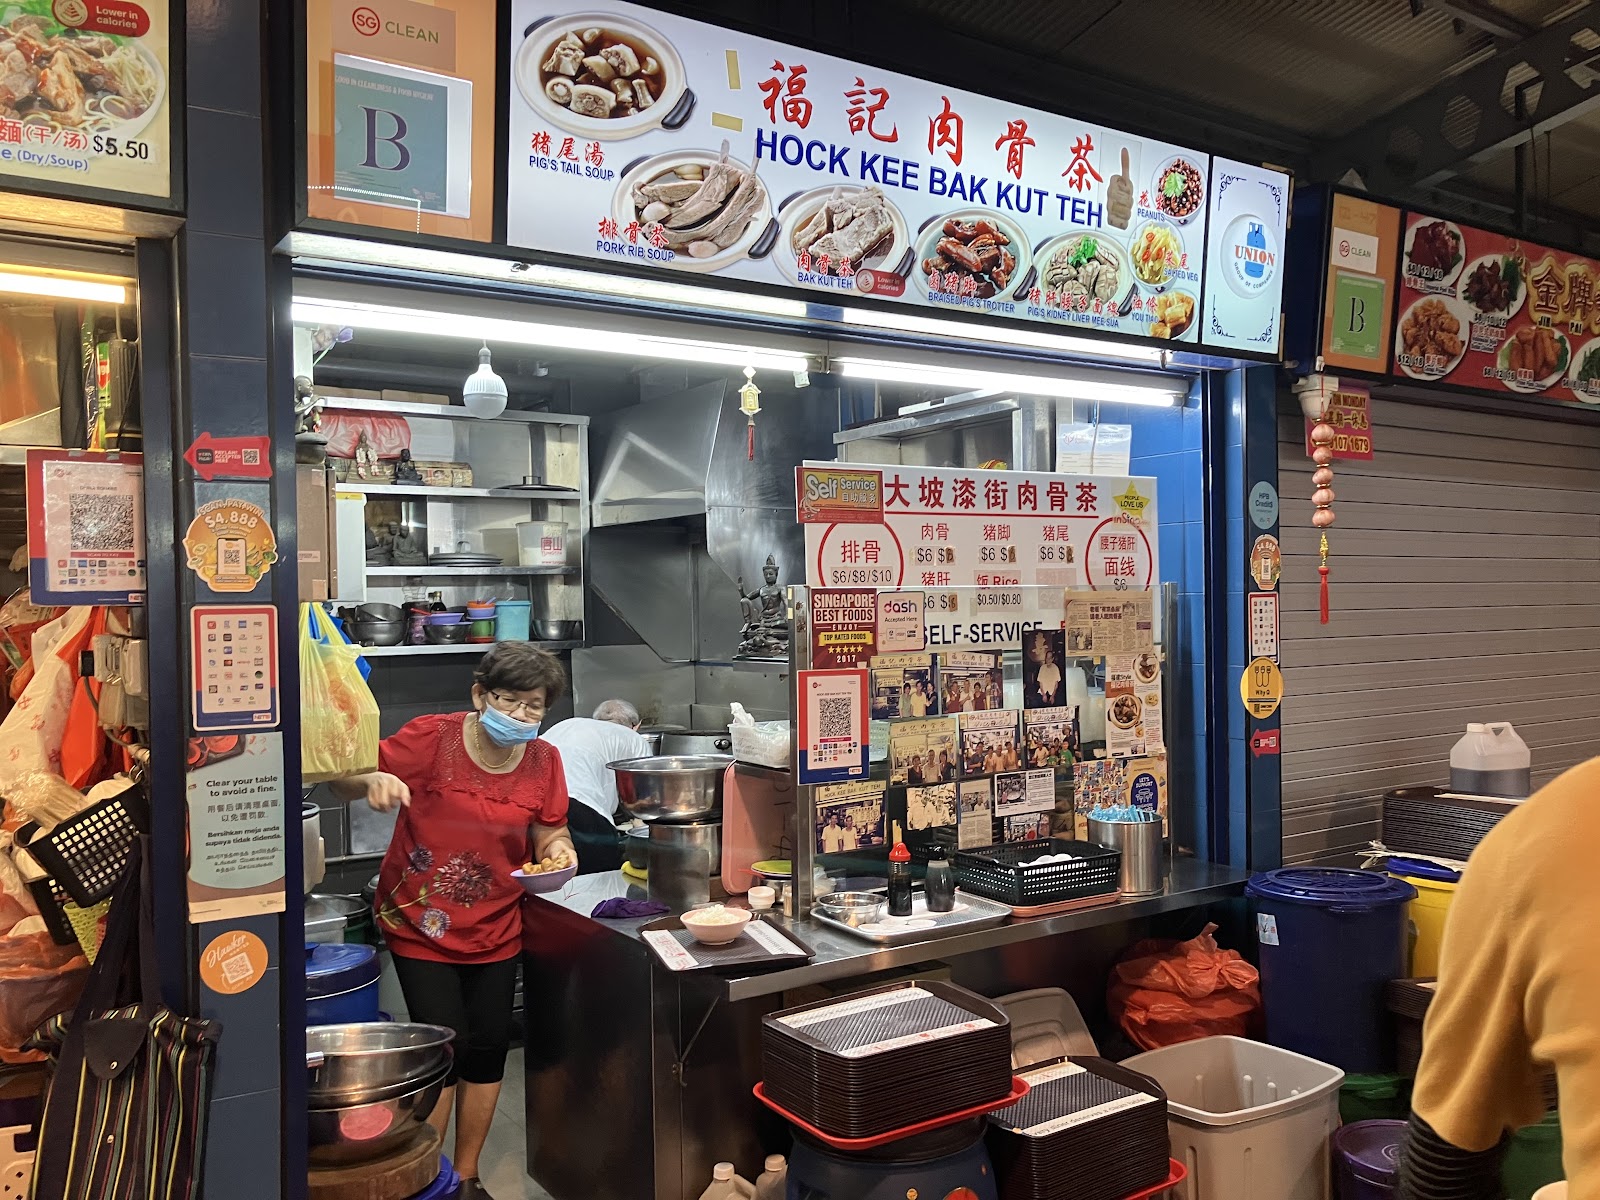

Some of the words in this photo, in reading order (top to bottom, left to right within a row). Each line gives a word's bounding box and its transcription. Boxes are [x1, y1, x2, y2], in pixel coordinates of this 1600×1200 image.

[96, 5, 127, 19] Lower
[129, 10, 138, 20] in
[96, 16, 137, 29] calories
[356, 14, 377, 29] SG
[385, 21, 439, 44] CLEAN
[757, 59, 1104, 193] 福記肉骨茶
[358, 104, 411, 171] B
[93, 134, 149, 160] $5.50
[17, 149, 88, 171] (Dry/Soup)
[529, 155, 558, 172] PIG'S
[560, 161, 583, 177] TAIL
[585, 166, 615, 181] SOUP
[755, 127, 850, 177] HOCK
[860, 150, 920, 192] KEE
[928, 165, 989, 205] BAK
[996, 181, 1050, 217] KUT
[1055, 193, 1104, 228] TEH
[1137, 207, 1165, 222] PEANUTS
[596, 240, 627, 256] PORK
[628, 245, 646, 258] RIB
[647, 248, 676, 262] SOUP
[1234, 244, 1275, 266] UNION
[1351, 246, 1371, 258] CLEAN
[837, 277, 854, 290] TEH
[1186, 271, 1199, 282] VEG
[983, 299, 1016, 314] TROTTER
[1131, 311, 1145, 321] YOU
[1348, 297, 1367, 333] B
[806, 473, 839, 501] Self
[840, 477, 877, 491] Service
[884, 473, 1098, 513] 大坡漆街肉骨茶
[1258, 492, 1270, 500] HPB
[1120, 500, 1135, 508] LOVE
[1135, 501, 1144, 509] US
[204, 511, 258, 529] $4,888
[921, 522, 950, 541] 肉骨
[983, 524, 1012, 541] 猪脚
[1043, 524, 1070, 542] 猪尾
[1100, 535, 1136, 552] 腰子猪肝
[841, 539, 881, 564] 排骨
[916, 548, 933, 562] $6
[980, 546, 996, 561] $6
[1040, 546, 1054, 561] $6
[1104, 556, 1136, 578] 面线
[832, 569, 893, 584] $6/$8/$10
[921, 571, 951, 587] 猪肝
[993, 575, 1019, 587] Rice
[1113, 578, 1129, 592] $6
[813, 593, 875, 608] SINGAPORE
[883, 599, 918, 613] dash
[976, 593, 1022, 606] $0.50/$0.80
[815, 609, 840, 622] BEST
[842, 609, 873, 621] FOODS
[832, 623, 859, 631] ENJOY
[850, 632, 867, 640] FOODS
[836, 655, 857, 663] 2017
[206, 780, 231, 788] Clear
[232, 778, 254, 787] your
[255, 775, 279, 784] table
[222, 787, 248, 796] avoid
[257, 785, 277, 793] fine.
[207, 829, 244, 838] Bersihkan
[244, 827, 262, 835] meja
[205, 839, 232, 847] supaya
[232, 836, 251, 844] tidak
[206, 934, 247, 969] Hawker
